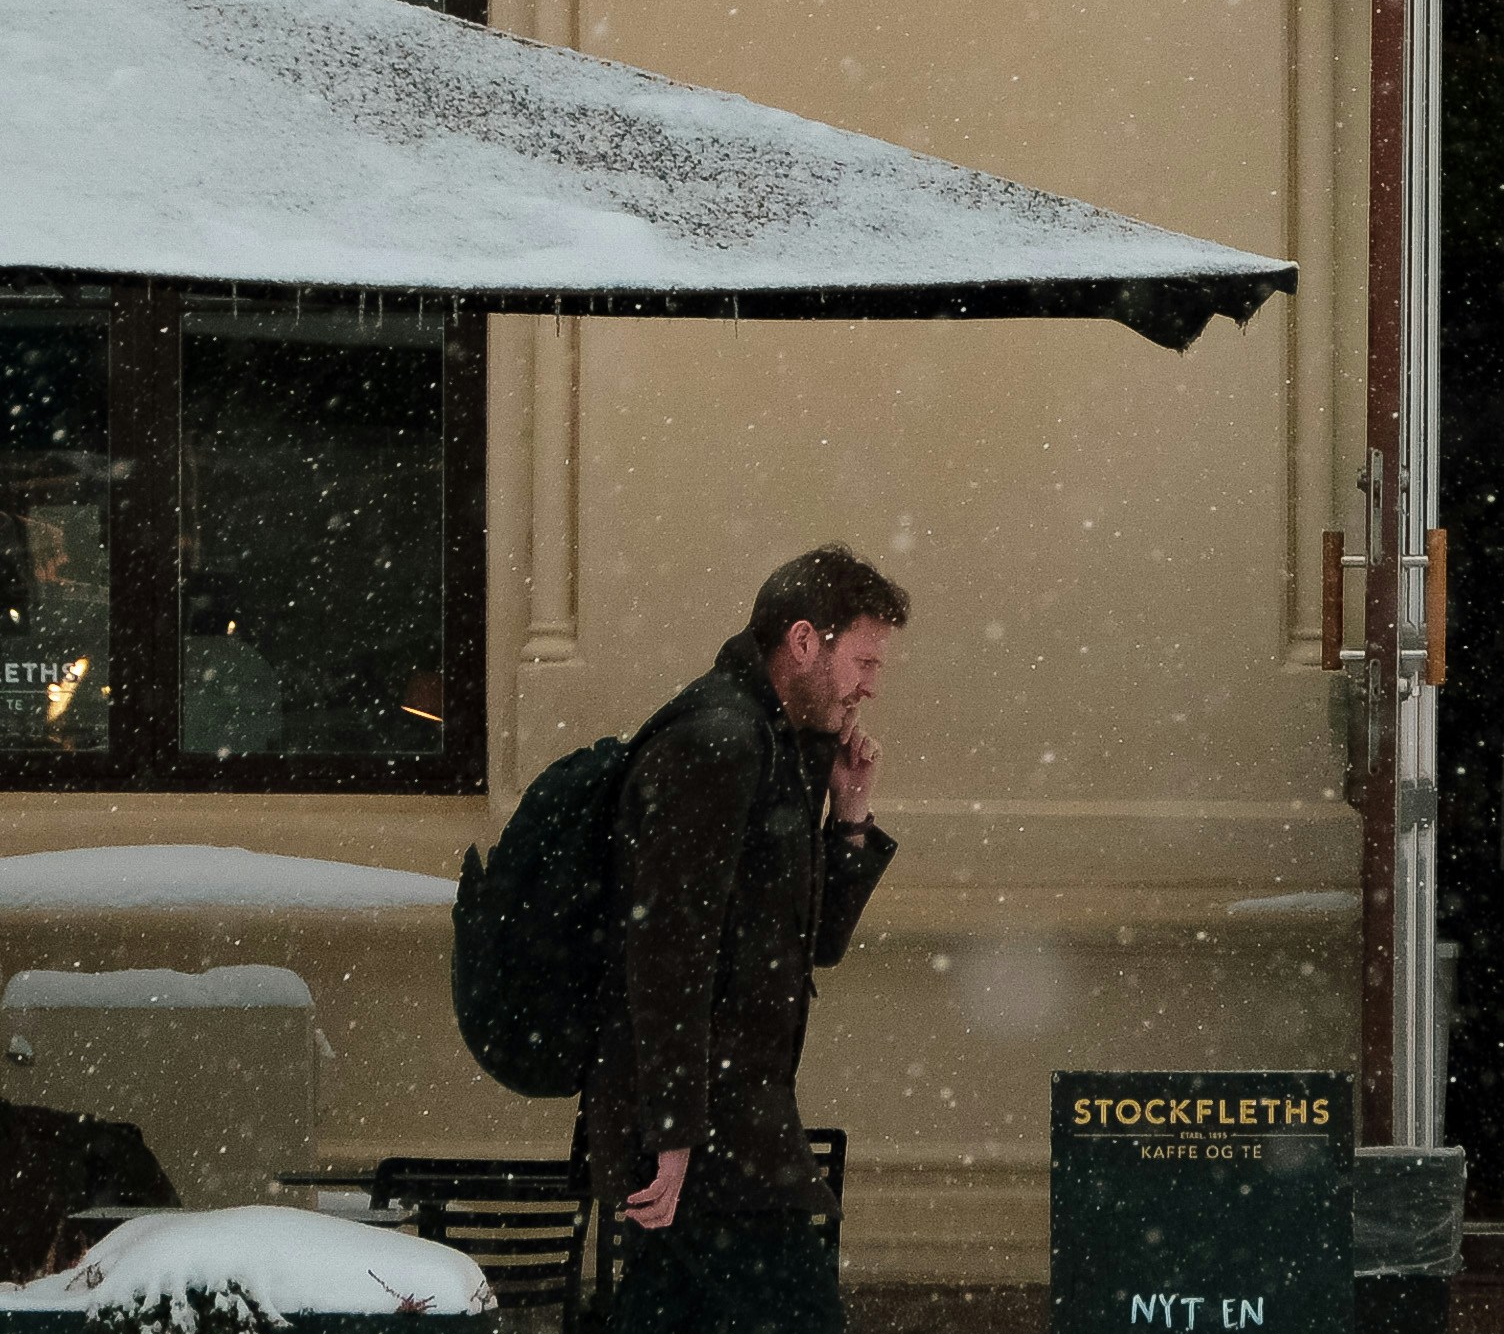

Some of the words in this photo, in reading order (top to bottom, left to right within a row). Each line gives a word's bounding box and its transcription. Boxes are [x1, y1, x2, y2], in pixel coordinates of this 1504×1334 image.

[7, 699, 24, 711] TE
[1074, 1098, 1330, 1125] STOCKFLETHS
[1141, 1145, 1198, 1159] KAFFE
[1205, 1145, 1234, 1159] OG
[1242, 1145, 1262, 1159] TE
[1130, 1293, 1205, 1330] NYT
[1222, 1296, 1264, 1329] EN
